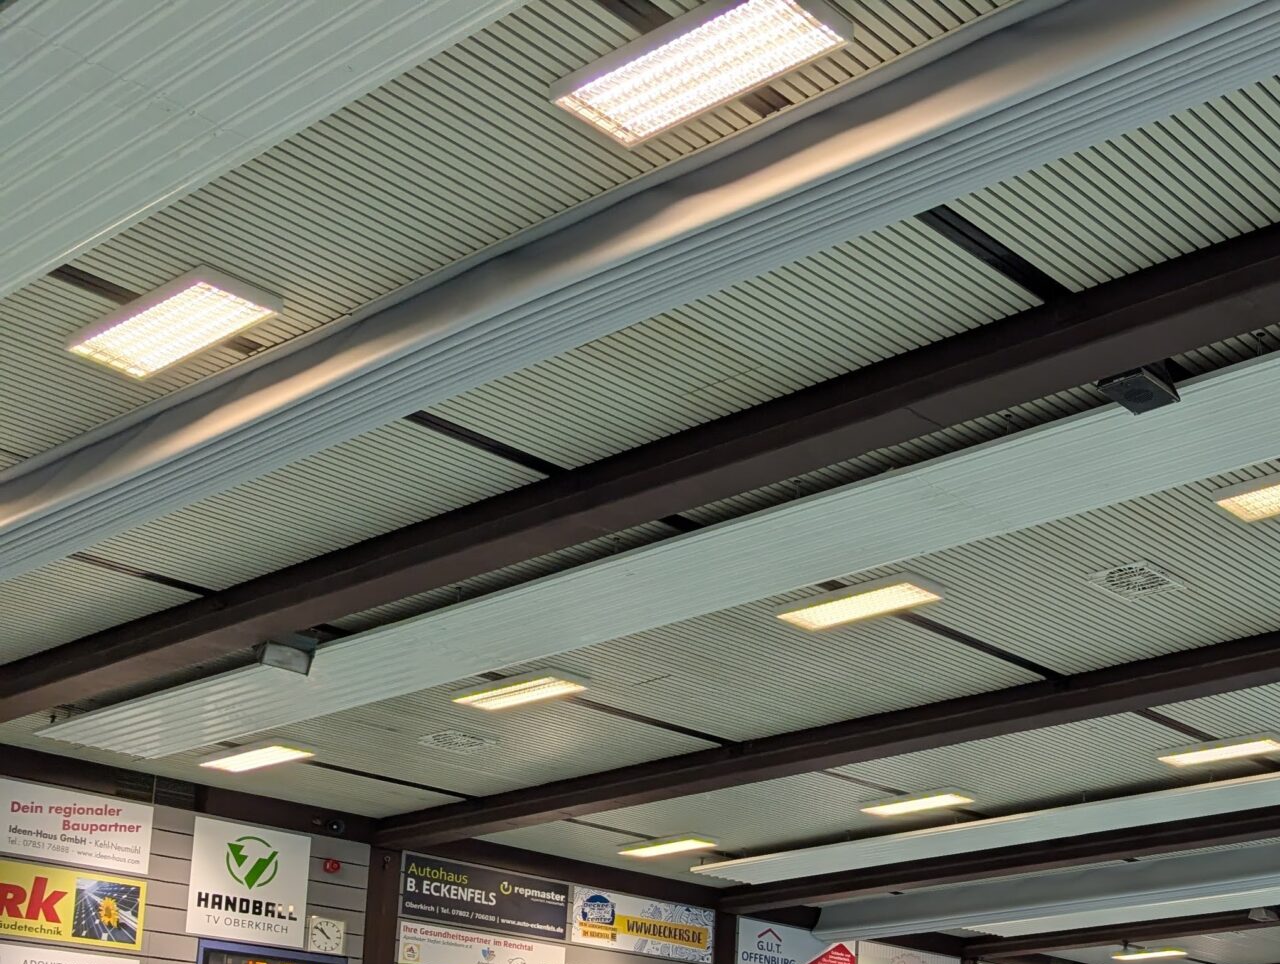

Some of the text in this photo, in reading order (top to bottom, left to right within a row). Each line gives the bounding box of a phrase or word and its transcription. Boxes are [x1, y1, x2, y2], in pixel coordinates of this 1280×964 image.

[10, 800, 123, 818] Dein regionaler
[8, 824, 87, 846] Ideen-Haus GmbH
[62, 819, 142, 834] Baupartner
[408, 863, 468, 884] Autohaus
[406, 878, 497, 906] B. ECKENFELS
[514, 886, 565, 902] repmaster
[197, 892, 297, 921] HANDBALL
[206, 914, 288, 934] TV OBERKIRCH
[626, 919, 703, 944] WWW.DECKERS.DE
[403, 925, 418, 935] Ihre
[419, 926, 492, 946] Gesundheitspartner
[493, 939, 502, 947] im
[503, 940, 534, 951] Renchtal
[757, 941, 782, 954] G.U.T.
